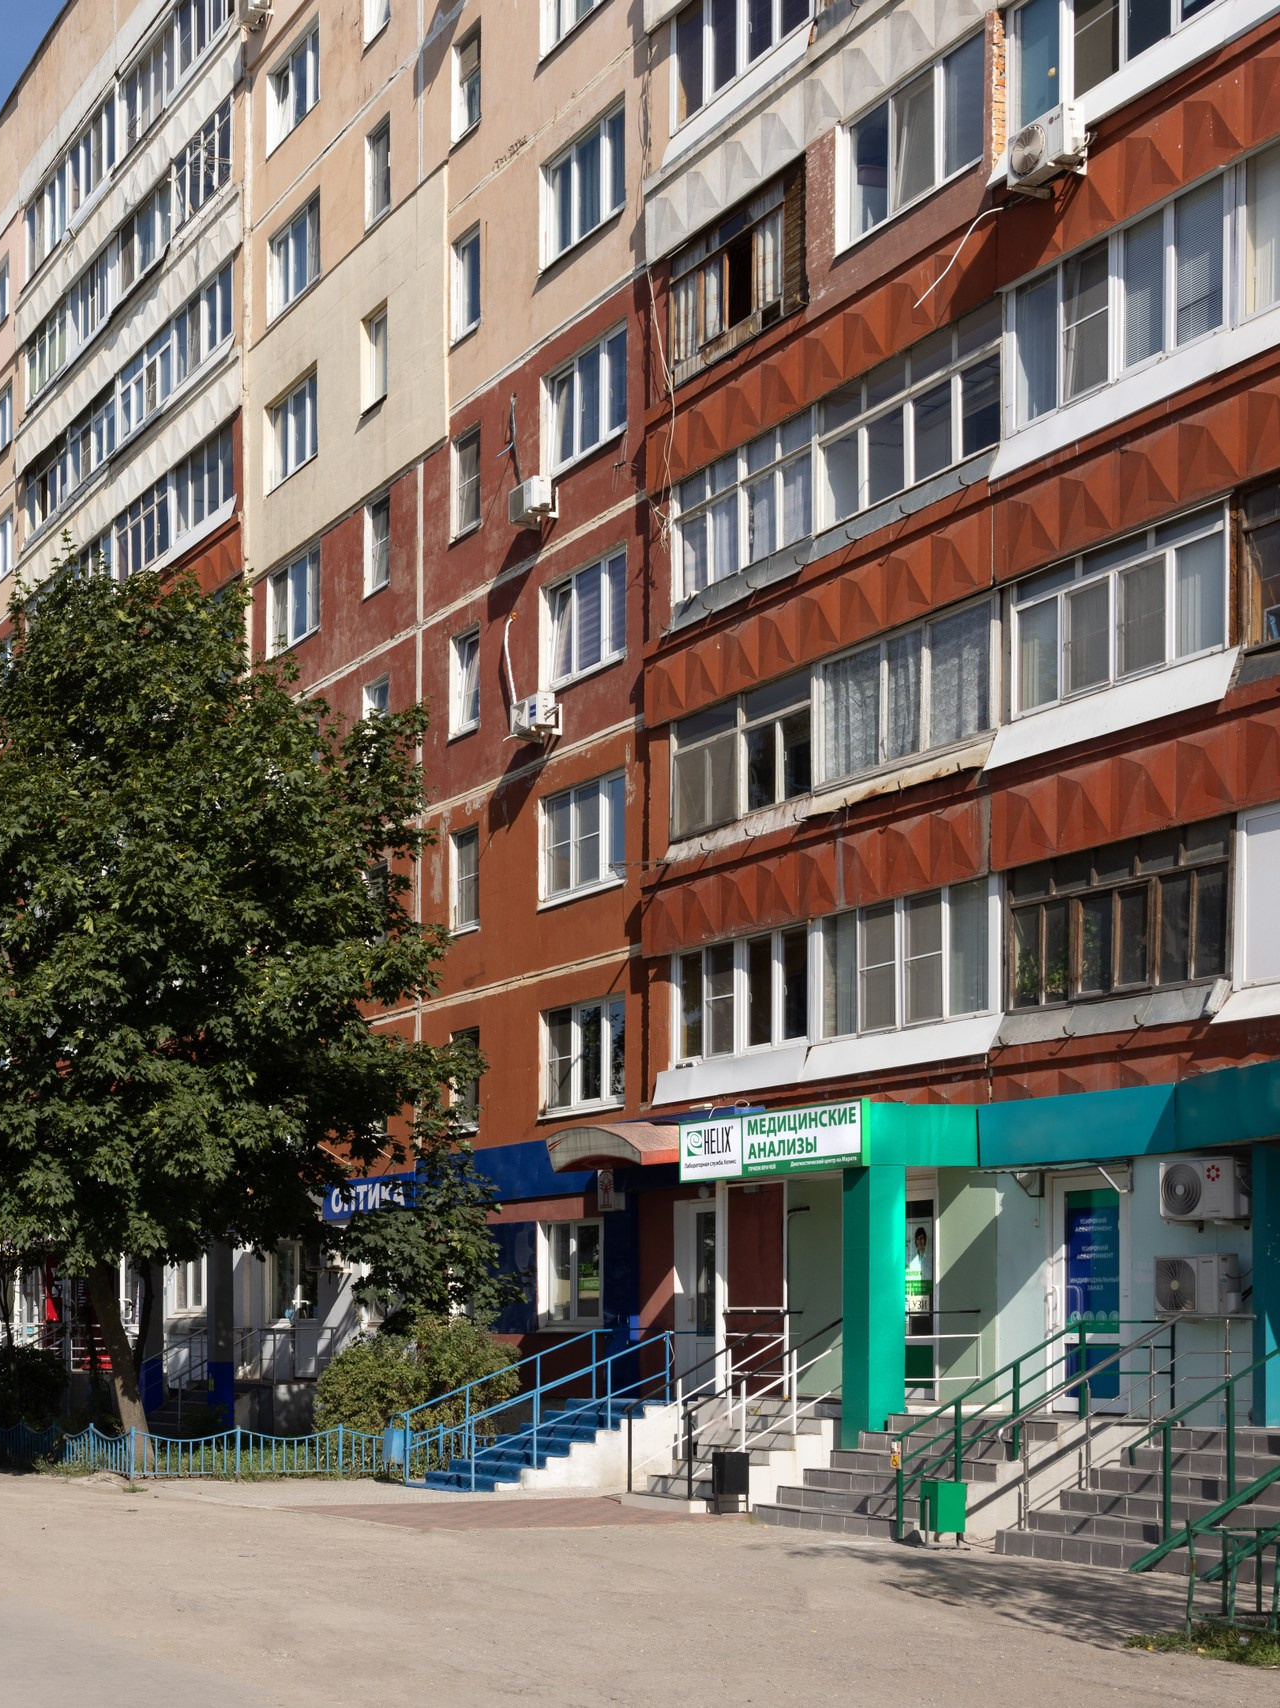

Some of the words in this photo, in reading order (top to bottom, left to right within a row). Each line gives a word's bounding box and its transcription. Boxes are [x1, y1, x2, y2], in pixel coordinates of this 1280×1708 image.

[747, 1106, 857, 1138] МЕДИЦИНСКИЕ
[703, 1126, 732, 1155] HELIX
[747, 1136, 817, 1160] АНАЛИЗЫ
[790, 1158, 823, 1168] Диагностический
[842, 1155, 857, 1163] Марата
[331, 1181, 405, 1213] ОПТИКА
[1080, 1217, 1107, 1225] ШИРОКИЙ
[1081, 1244, 1109, 1252] ШИРОКИЙ
[1070, 1276, 1119, 1285] ИНДИВИДУАЛЬНЫЙ
[912, 1300, 928, 1310] УЗИ
